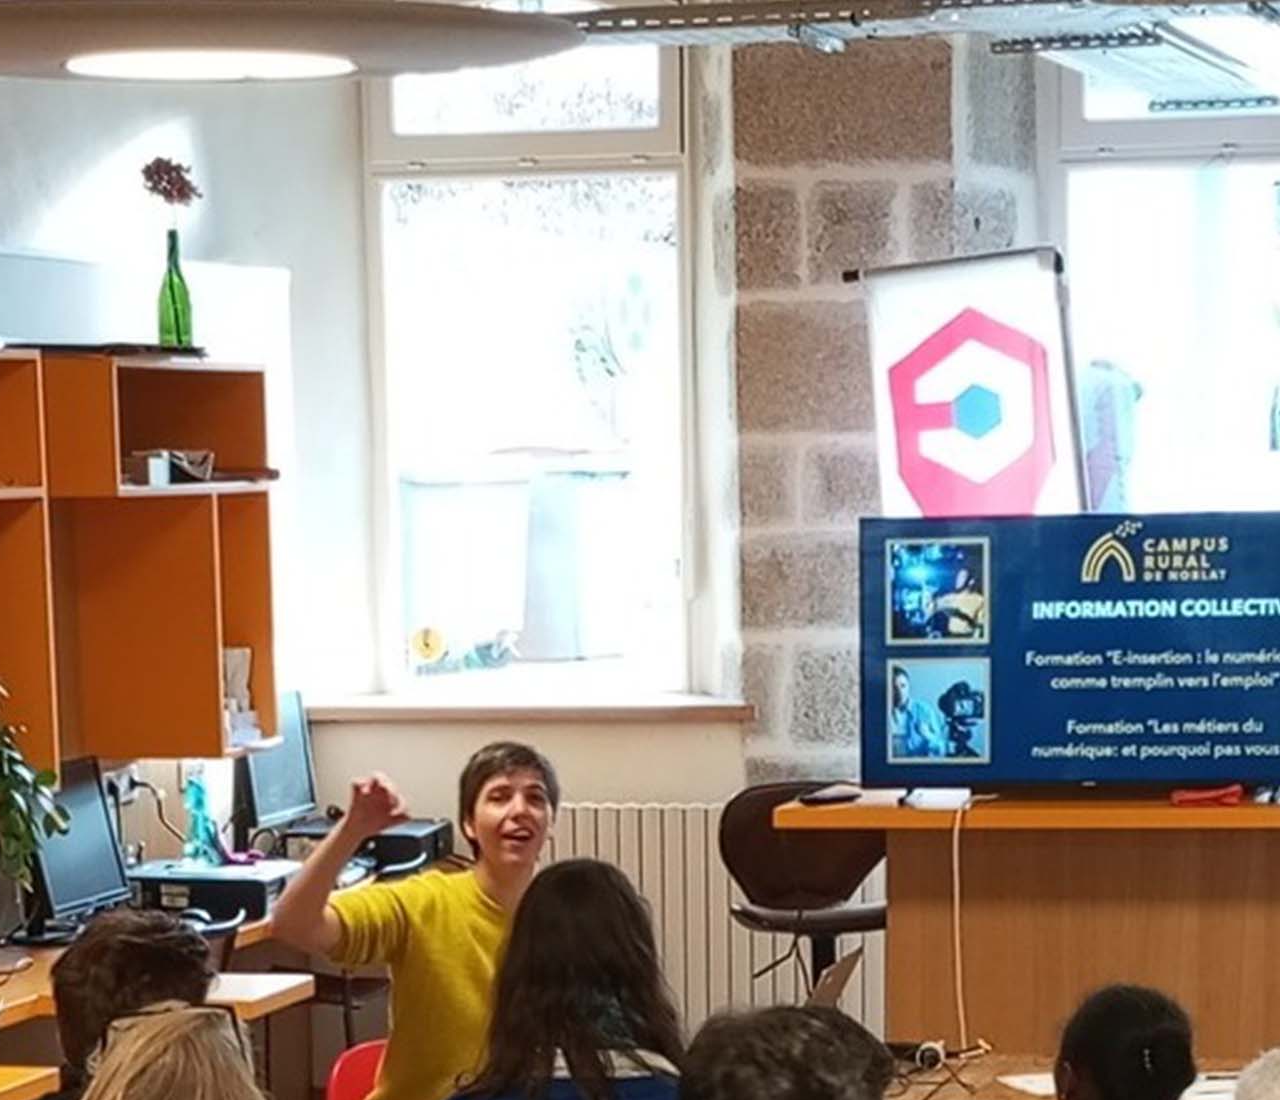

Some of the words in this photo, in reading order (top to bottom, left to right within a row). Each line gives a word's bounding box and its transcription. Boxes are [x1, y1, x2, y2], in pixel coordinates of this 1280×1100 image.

[1142, 537, 1229, 552] CAMPUS
[1143, 554, 1210, 569] RURAL
[1143, 571, 1162, 581] DE
[1167, 568, 1228, 581] NOBLAT
[1032, 599, 1177, 619] INFORMATION
[1025, 650, 1103, 666] Formation
[1204, 648, 1219, 664] le
[1051, 677, 1107, 689] comme
[1110, 673, 1174, 691] tremplin
[1177, 676, 1209, 688] vers
[1066, 719, 1144, 734] Formation
[1182, 718, 1239, 733] métiers
[1242, 717, 1264, 733] du
[1121, 744, 1138, 757] et
[1140, 741, 1211, 760] pourquoi
[1213, 744, 1241, 759] pas
[1244, 743, 1280, 756] vous
